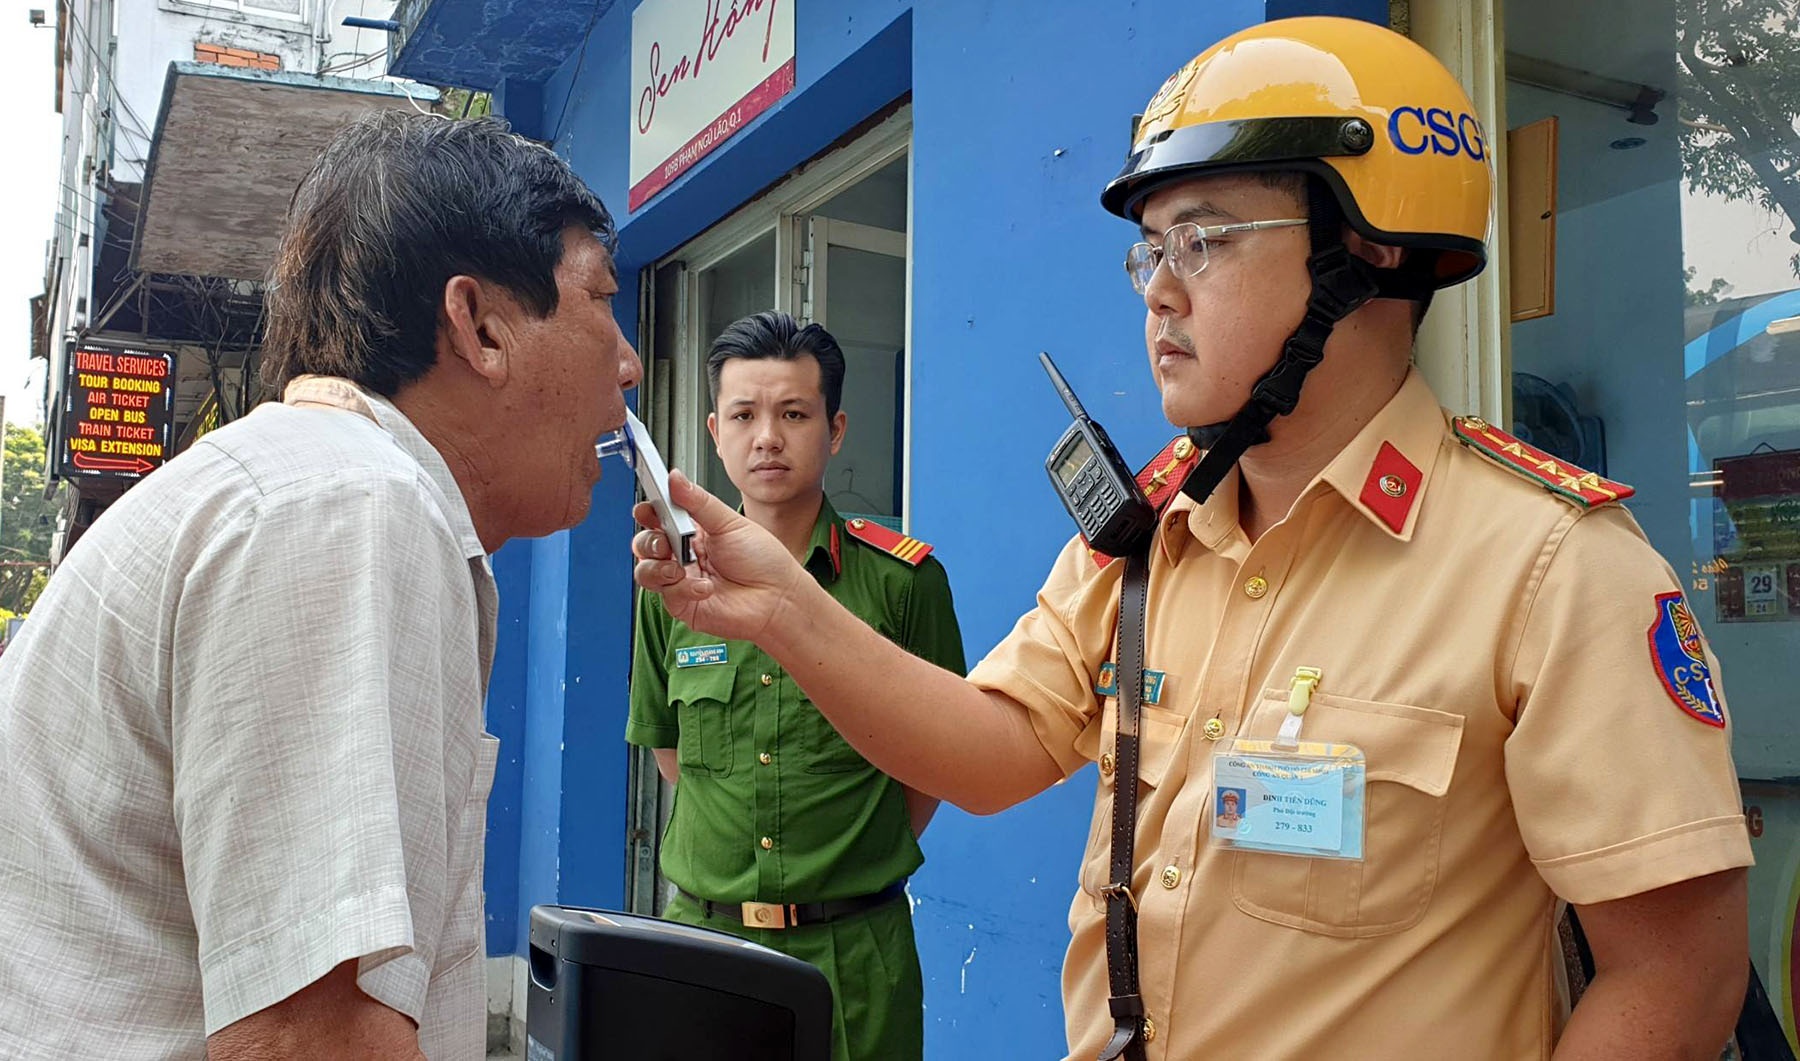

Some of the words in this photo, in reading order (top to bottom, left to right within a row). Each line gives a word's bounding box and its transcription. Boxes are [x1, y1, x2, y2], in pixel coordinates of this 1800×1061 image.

[638, 41, 691, 135] Sen
[76, 352, 115, 373] TRAVEL
[117, 356, 166, 377] SERVICES
[79, 373, 109, 389] TOUR
[112, 376, 161, 394] BOOKING
[87, 391, 107, 405] AIR
[111, 393, 150, 408] TICKET
[89, 407, 119, 422] OPEN
[123, 410, 146, 424] BUS
[78, 422, 111, 437] TRAIN
[116, 425, 155, 440] TICKET
[70, 437, 96, 452] VISA
[100, 440, 162, 457] EXTENSION
[1751, 574, 1772, 594] 29
[1275, 821, 1290, 830] 279
[1297, 824, 1313, 833] 833
